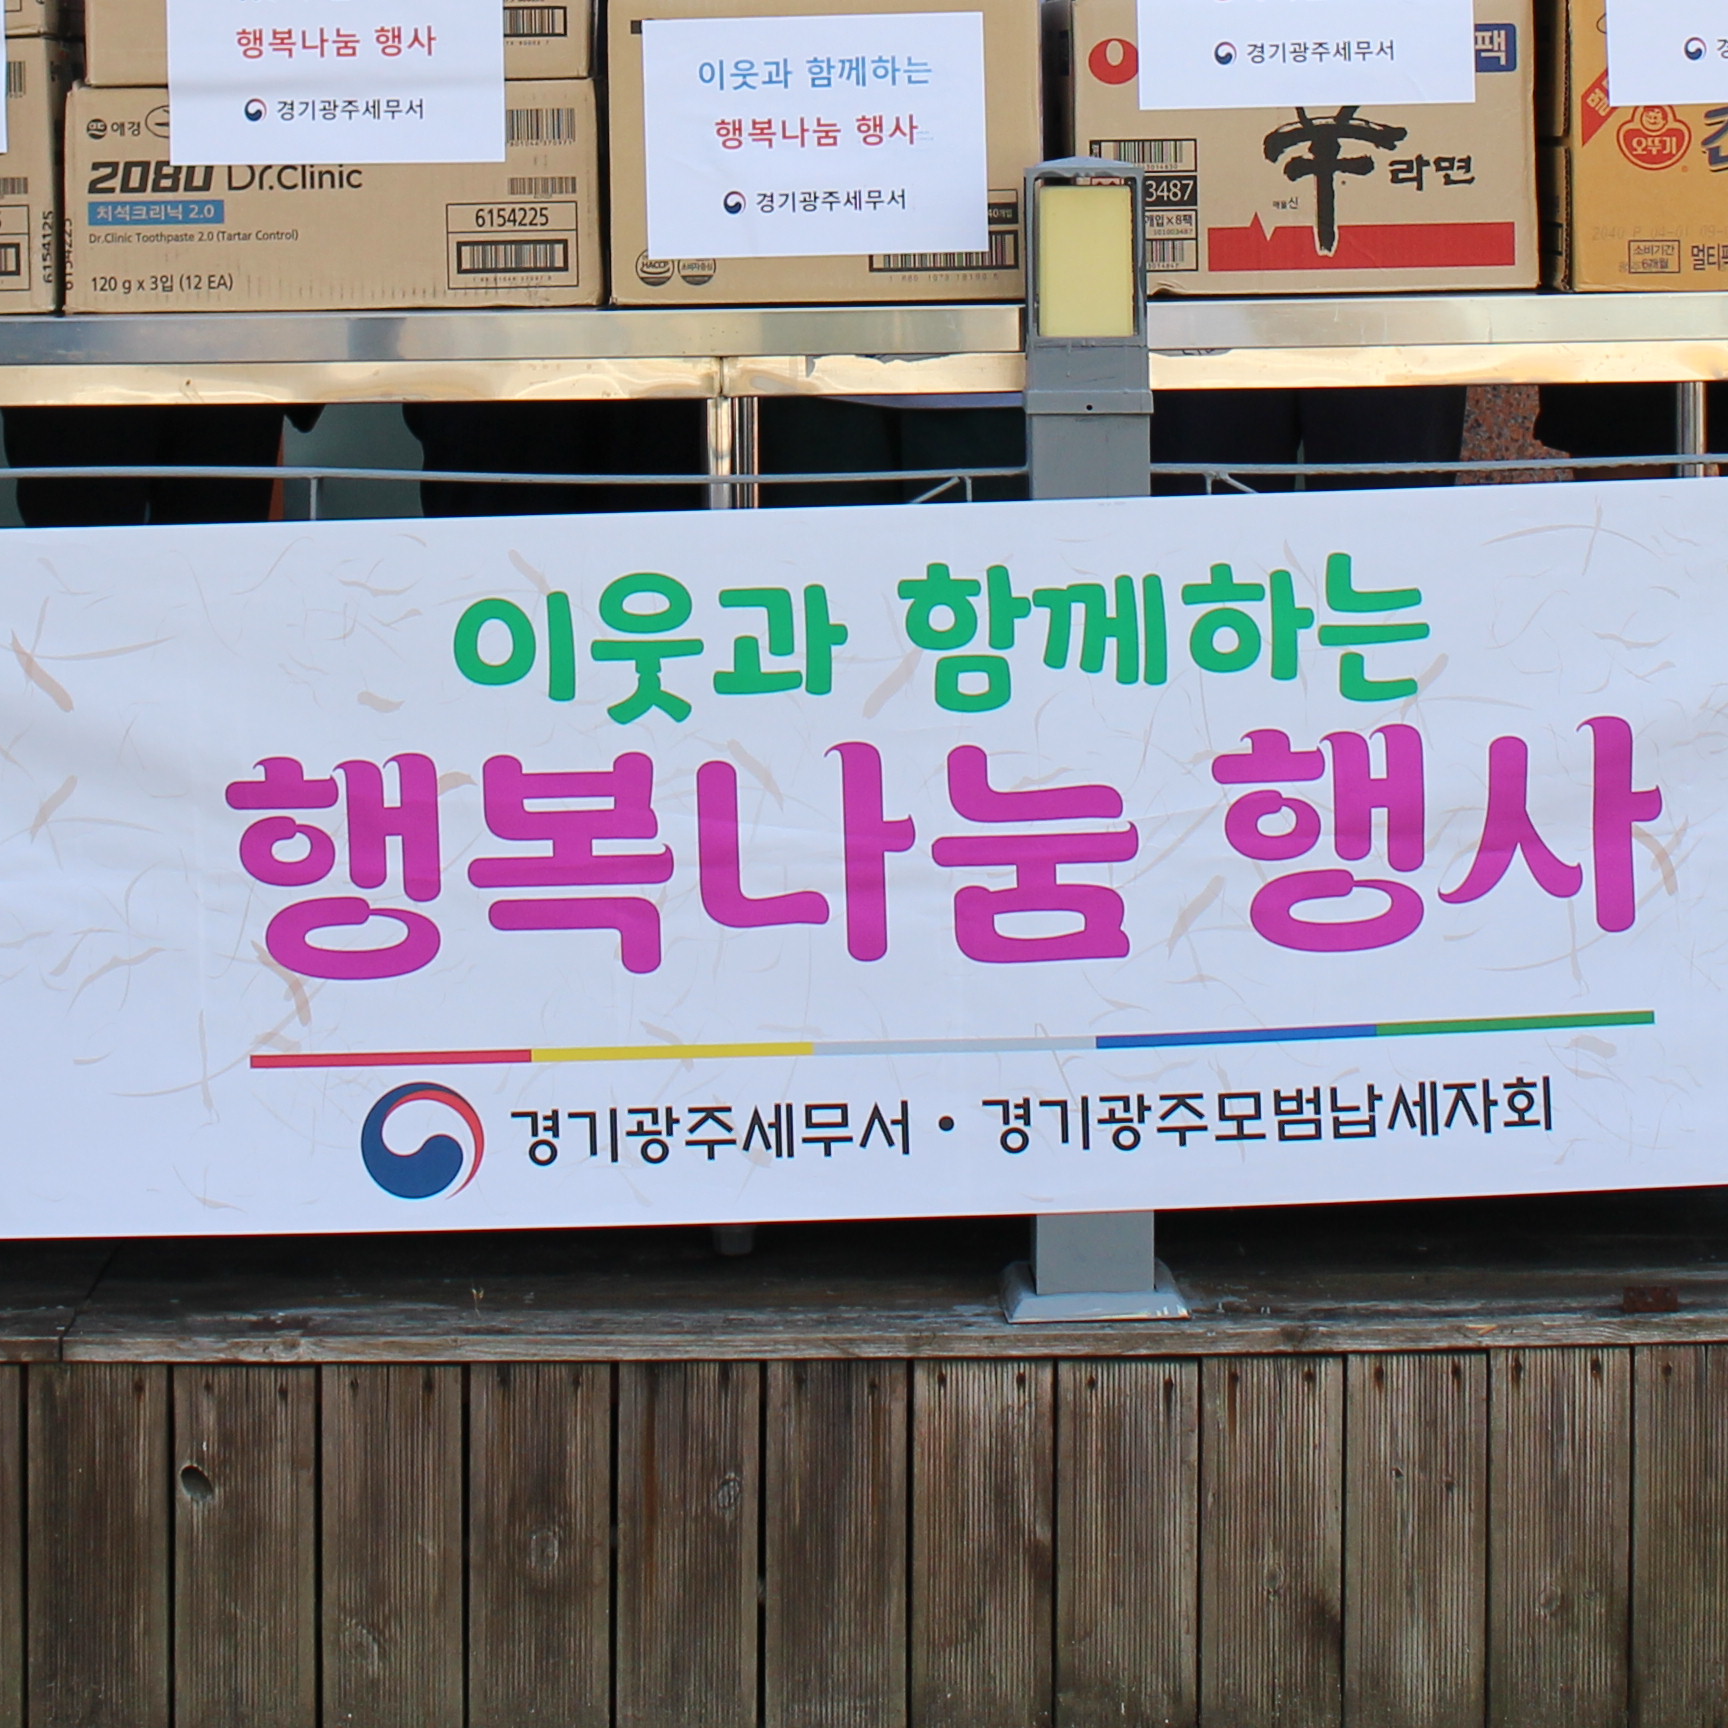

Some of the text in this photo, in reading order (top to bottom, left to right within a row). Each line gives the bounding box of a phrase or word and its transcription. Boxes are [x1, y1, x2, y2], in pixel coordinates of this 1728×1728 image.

[236, 25, 437, 60] 행복나눔 행사
[1246, 39, 1396, 64] 경기광주세무서
[698, 55, 933, 91] 이웃과 함께하는
[275, 98, 425, 121] 경기광주세무서
[110, 120, 141, 137] 애경
[715, 113, 919, 150] 행복나눔 행사
[1631, 135, 1677, 156] 오뚜기
[87, 160, 363, 194] 2080 Dr.Clinic
[1387, 153, 1476, 192] 라면
[756, 188, 907, 214] 경기광주세무서
[1145, 179, 1194, 202] 3487
[96, 204, 215, 220] 치석크리닉 2.0
[475, 207, 550, 228] 6154225
[42, 210, 54, 284] 6154125
[88, 229, 299, 245] Dr.Clinic Toothpaste 2.0 (Tartar Control)
[1633, 244, 1675, 256] 소비기간
[1641, 258, 1670, 270] 6개월
[91, 276, 117, 292] 120
[122, 279, 132, 294] g
[150, 276, 174, 292] 3입
[179, 274, 202, 292] (12
[207, 273, 234, 292] EA)
[452, 551, 1432, 726] 이웃과 함께하는
[224, 715, 1664, 981] 행복나눔 행사
[509, 1075, 1555, 1166] 경기광주세무서 경기광주모범납세자회
